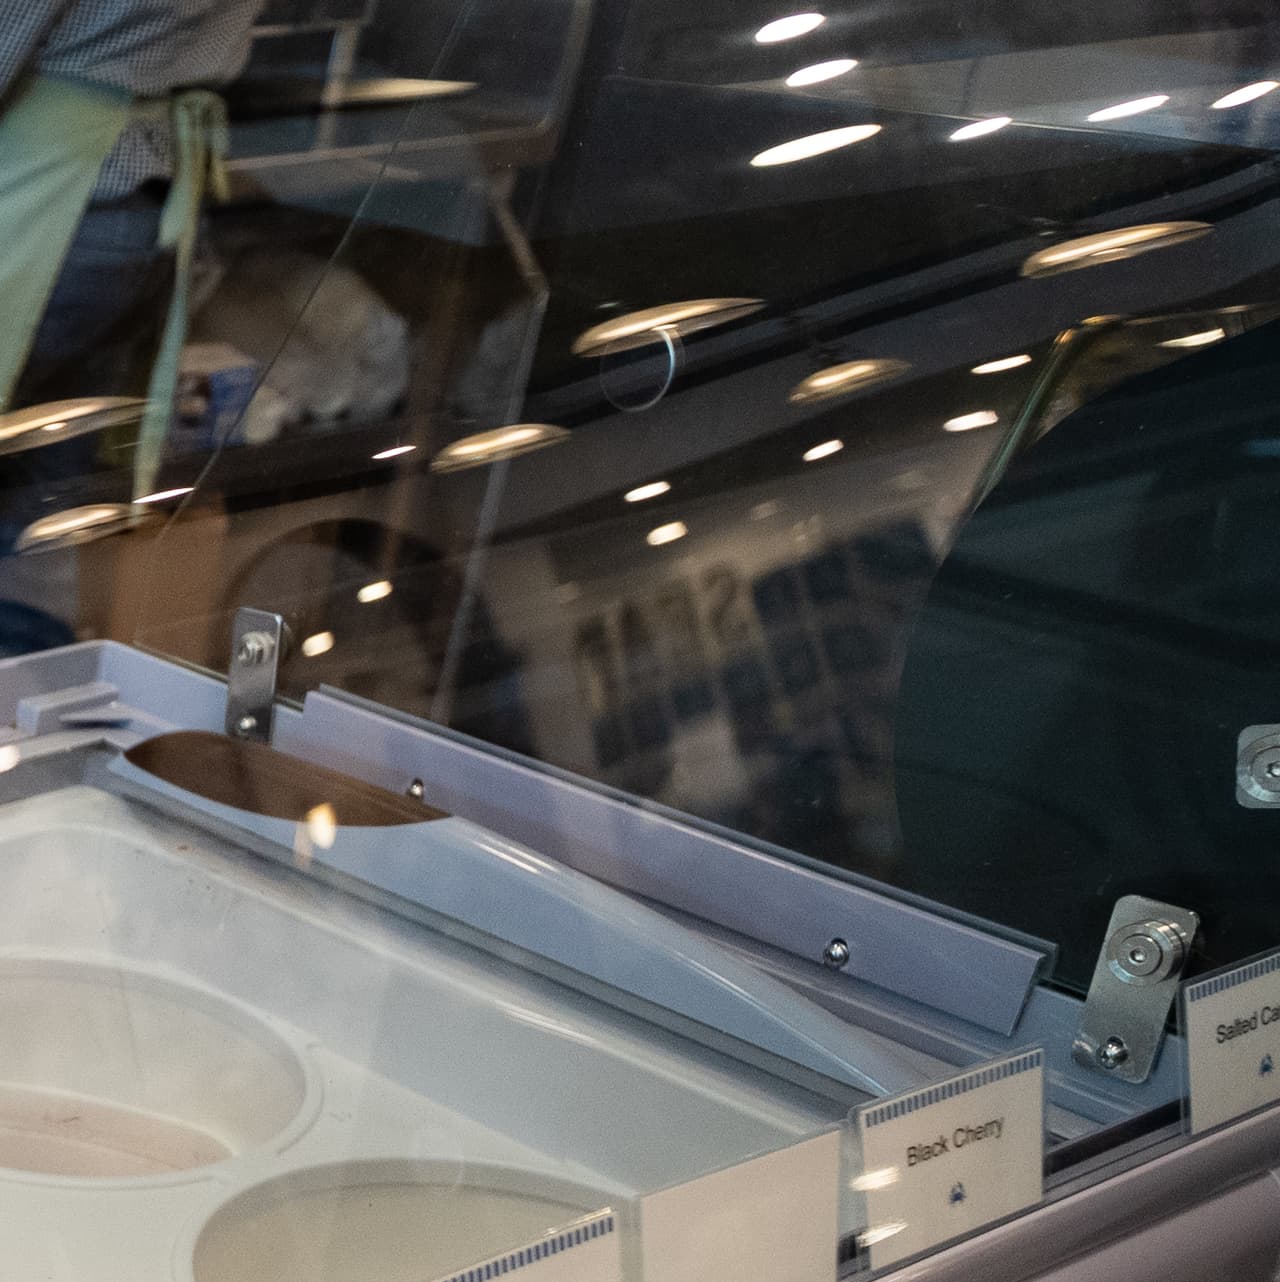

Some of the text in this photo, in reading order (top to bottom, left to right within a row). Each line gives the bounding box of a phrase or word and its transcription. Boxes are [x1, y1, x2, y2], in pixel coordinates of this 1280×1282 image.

[1216, 1005, 1280, 1044] Salted Ca
[907, 1117, 1005, 1167] Black Cherry
